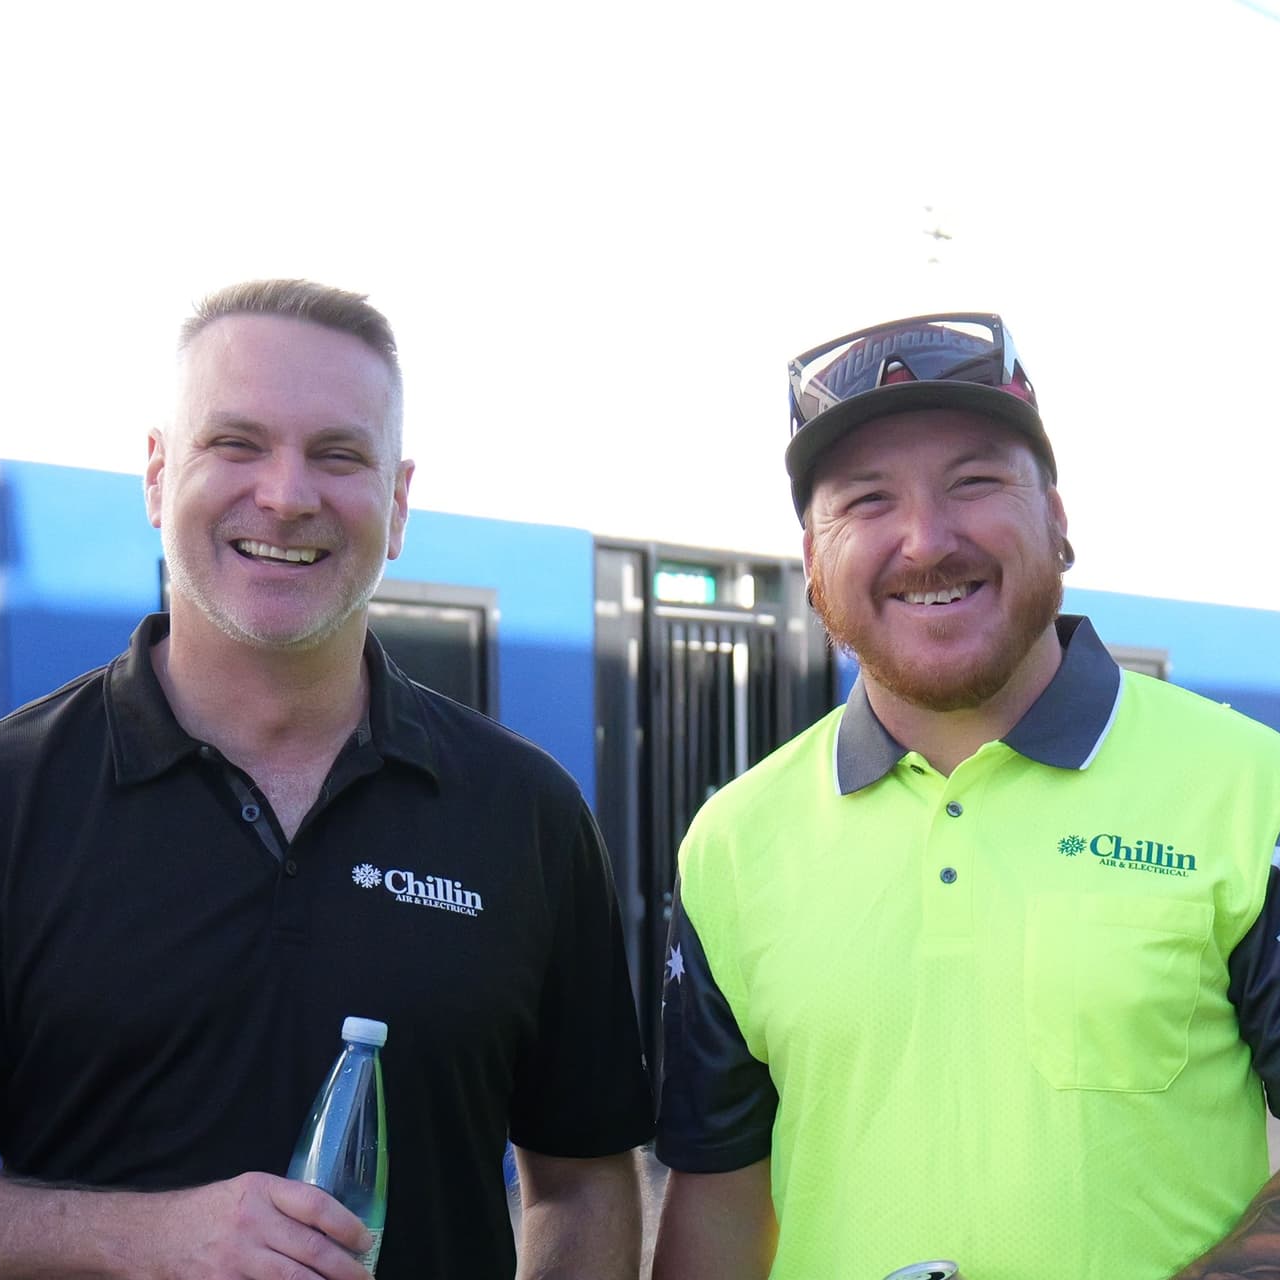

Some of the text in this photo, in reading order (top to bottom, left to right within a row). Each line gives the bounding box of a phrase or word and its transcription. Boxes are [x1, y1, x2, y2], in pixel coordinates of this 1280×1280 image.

[1089, 833, 1197, 871] Chillin
[1098, 858, 1117, 868] AIR
[1128, 862, 1189, 877] ELECTRICAL
[384, 869, 484, 911] Chillin
[395, 894, 478, 917] AIR & ELECTRICAL
